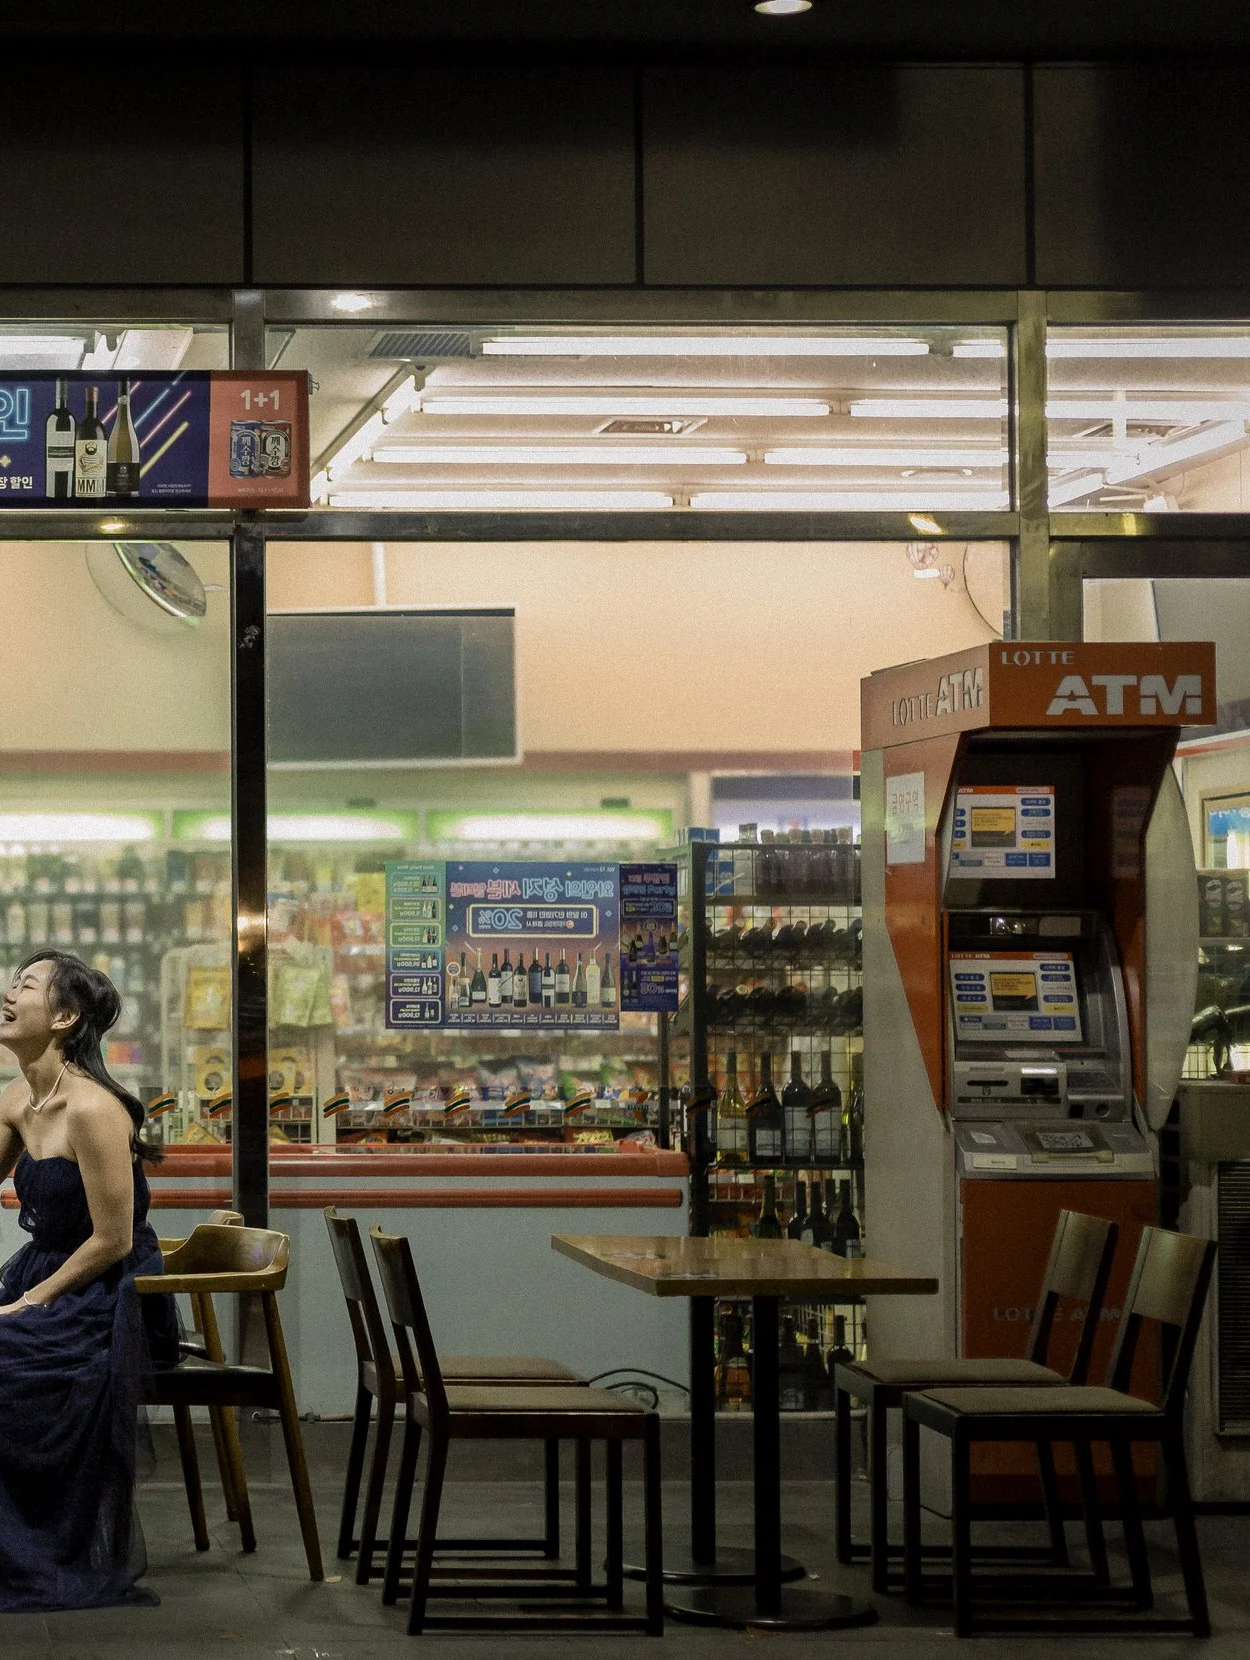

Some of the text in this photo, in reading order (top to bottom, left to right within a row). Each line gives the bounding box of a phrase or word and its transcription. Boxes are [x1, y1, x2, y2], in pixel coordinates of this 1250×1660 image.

[240, 389, 281, 411] 1+1
[10, 476, 33, 490] 할인
[1000, 650, 1076, 666] LOTTE
[891, 666, 984, 726] LOTTE ATM
[1046, 674, 1203, 716] ATM
